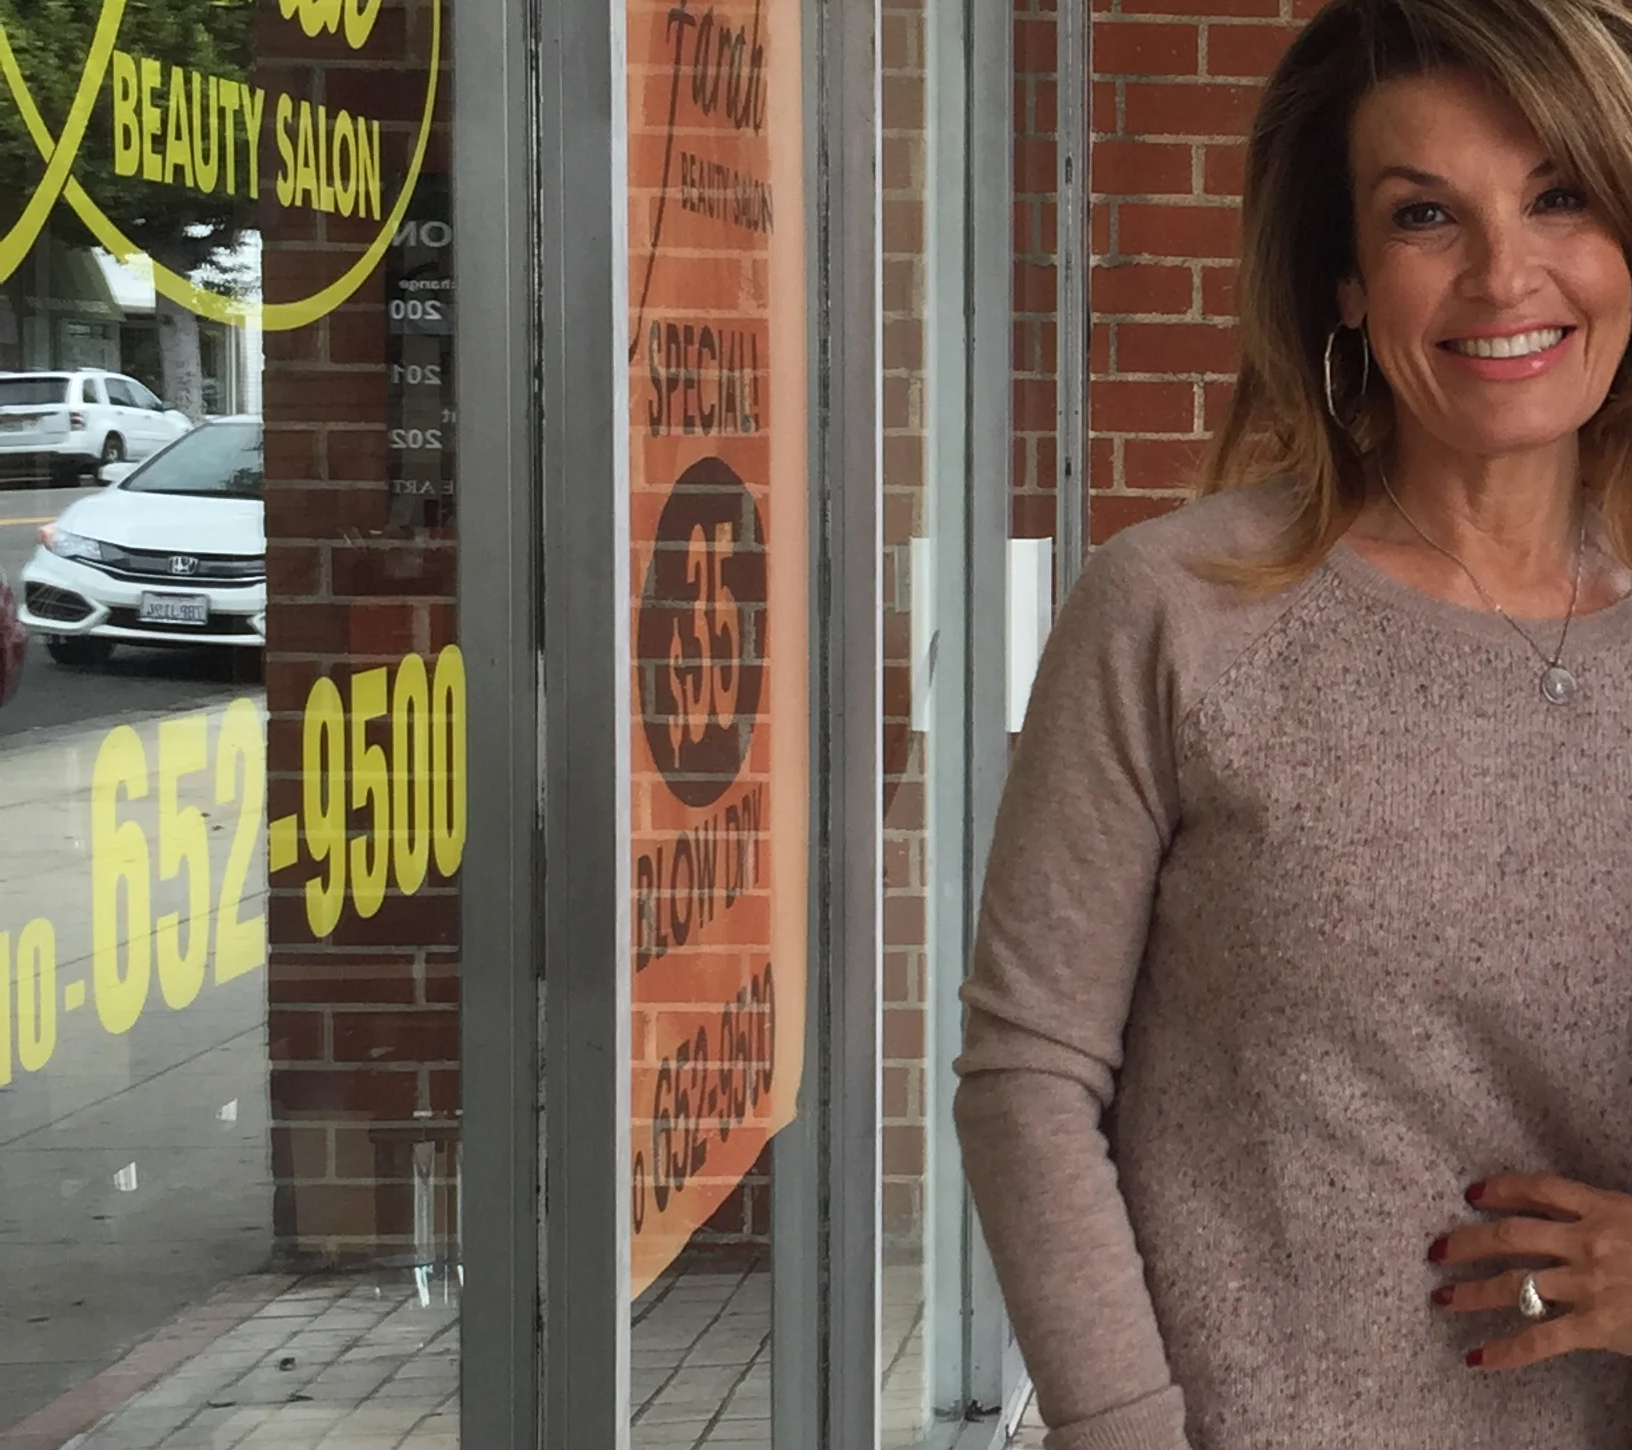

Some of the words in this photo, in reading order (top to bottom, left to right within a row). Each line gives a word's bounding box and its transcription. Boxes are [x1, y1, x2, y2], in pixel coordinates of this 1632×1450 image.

[113, 50, 265, 199] BEAUTY
[276, 92, 381, 220] SALON
[681, 151, 730, 222] BEAUTY
[733, 170, 774, 235] SALON
[648, 320, 760, 438] SPECIAL!
[669, 521, 740, 769] $35
[636, 819, 718, 973] BLOW
[725, 783, 762, 909] DRY
[652, 962, 775, 1213] 652-9500
